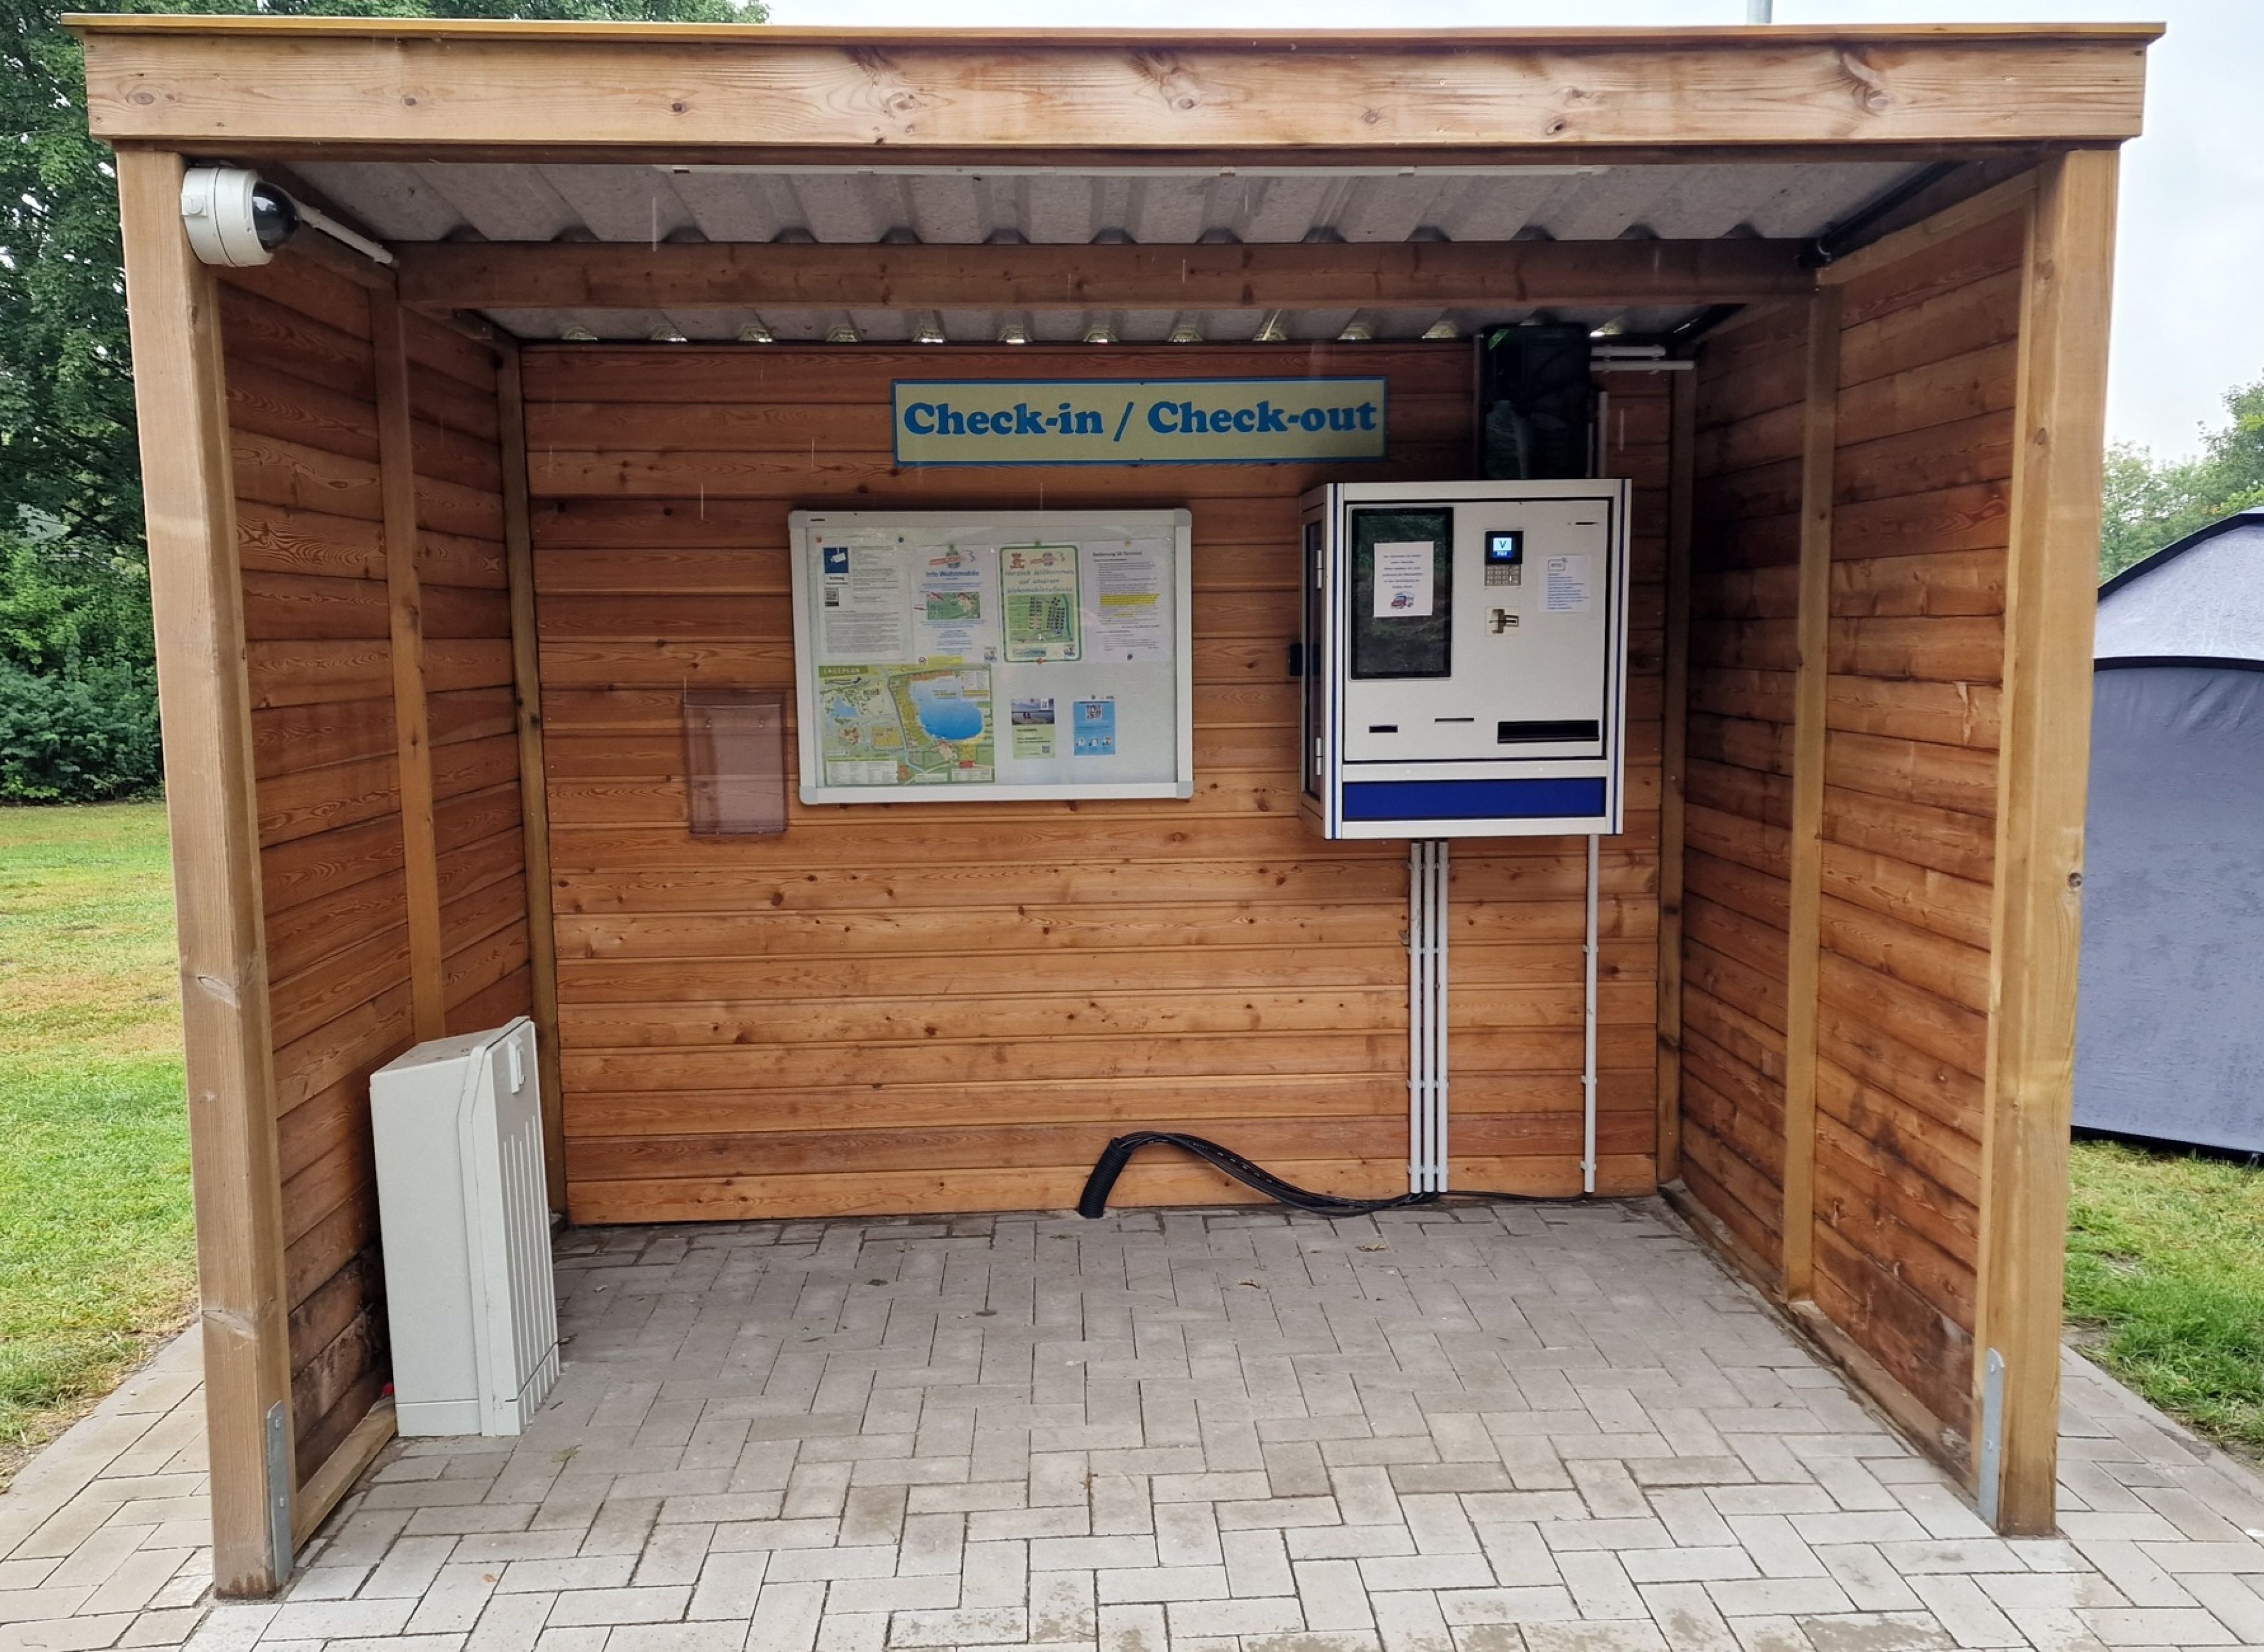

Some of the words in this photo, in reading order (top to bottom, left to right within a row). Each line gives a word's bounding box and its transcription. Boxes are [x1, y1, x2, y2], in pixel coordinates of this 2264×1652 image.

[904, 402, 1104, 435] Check-in
[1113, 401, 1134, 442] /
[1147, 401, 1377, 434] Check-out
[1499, 540, 1506, 548] V
